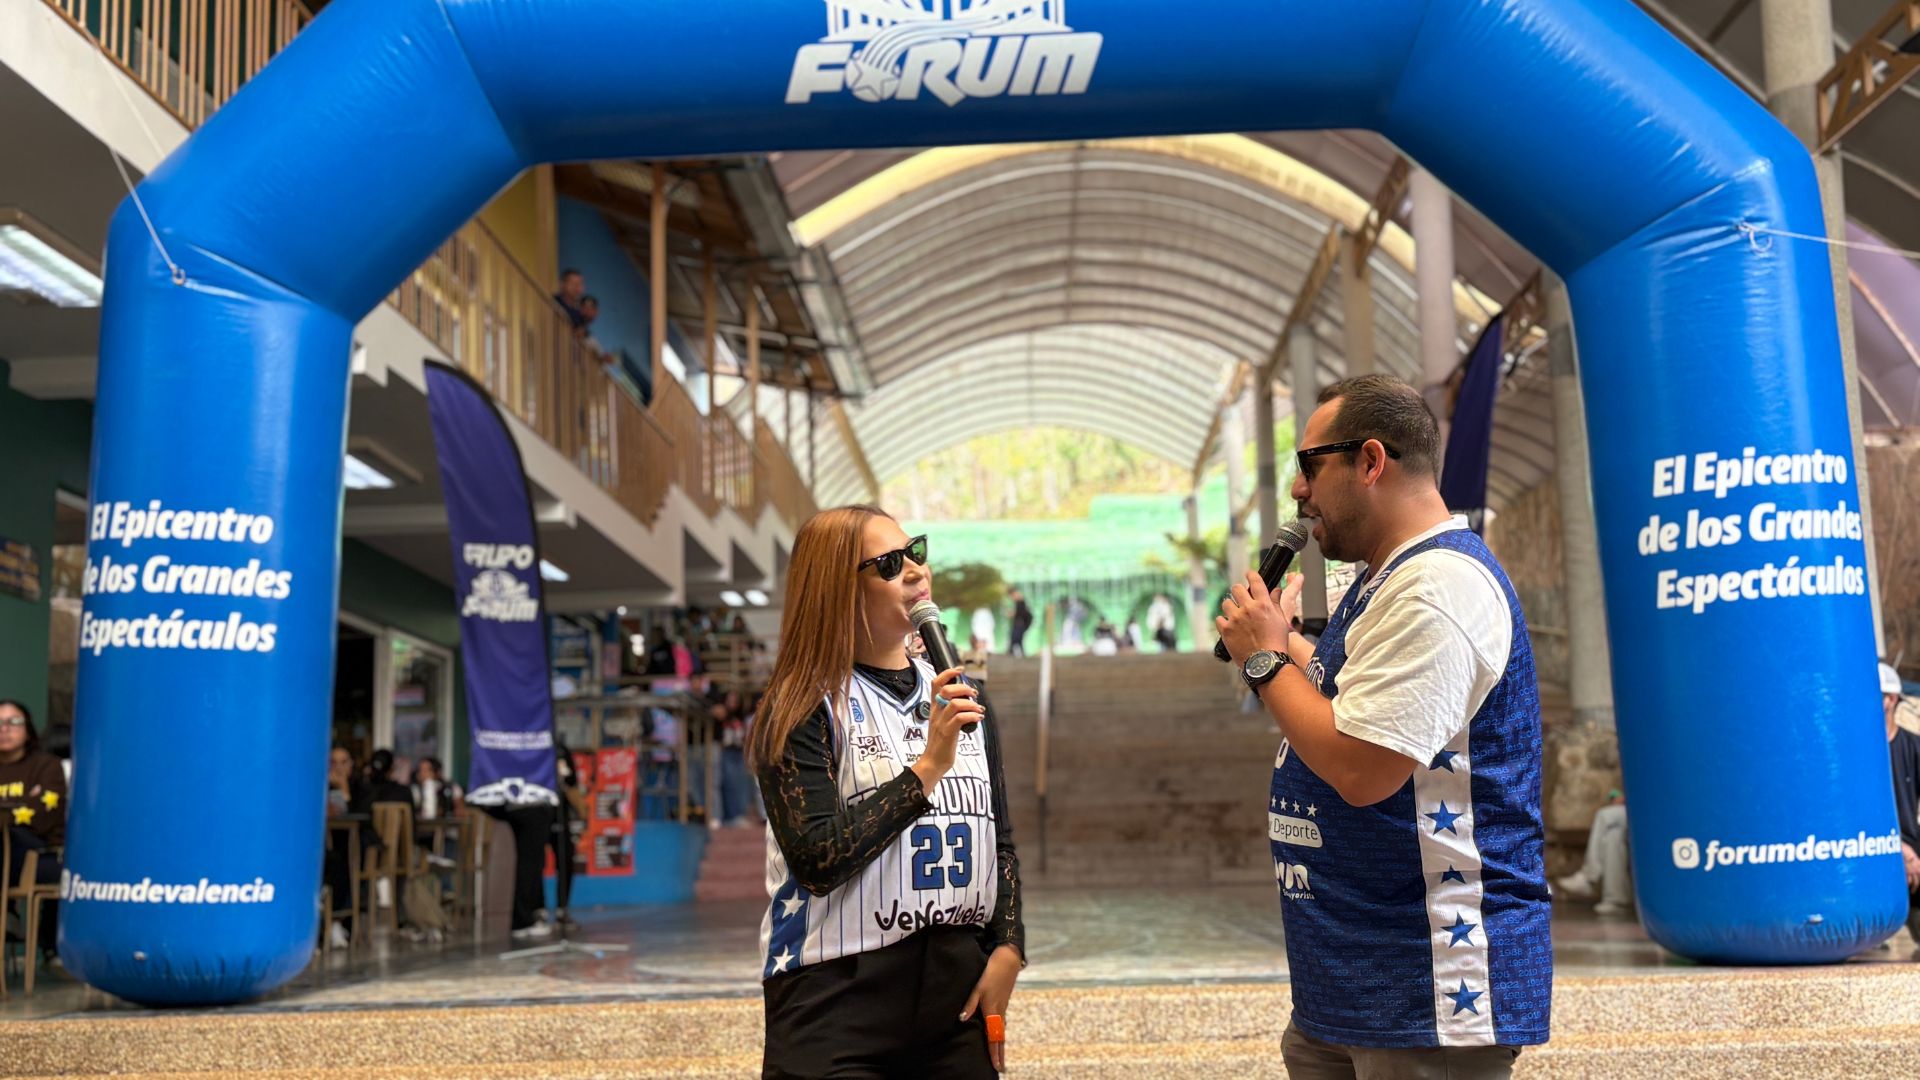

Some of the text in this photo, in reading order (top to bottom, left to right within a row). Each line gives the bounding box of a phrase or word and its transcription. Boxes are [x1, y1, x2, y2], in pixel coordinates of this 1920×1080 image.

[1653, 446, 1848, 499] El Epicentro
[90, 499, 274, 548] El Epicentro
[1638, 500, 1862, 556] de los Grandes
[98, 554, 139, 593] los
[142, 555, 293, 600] Grandes
[1656, 555, 1865, 615] Espectáculos
[80, 608, 278, 657] Espectáculos
[1274, 818, 1318, 840] Deporte
[1704, 828, 1900, 872] forumdevalencia
[911, 823, 972, 890] 23
[68, 877, 274, 903] forumdevalencia
